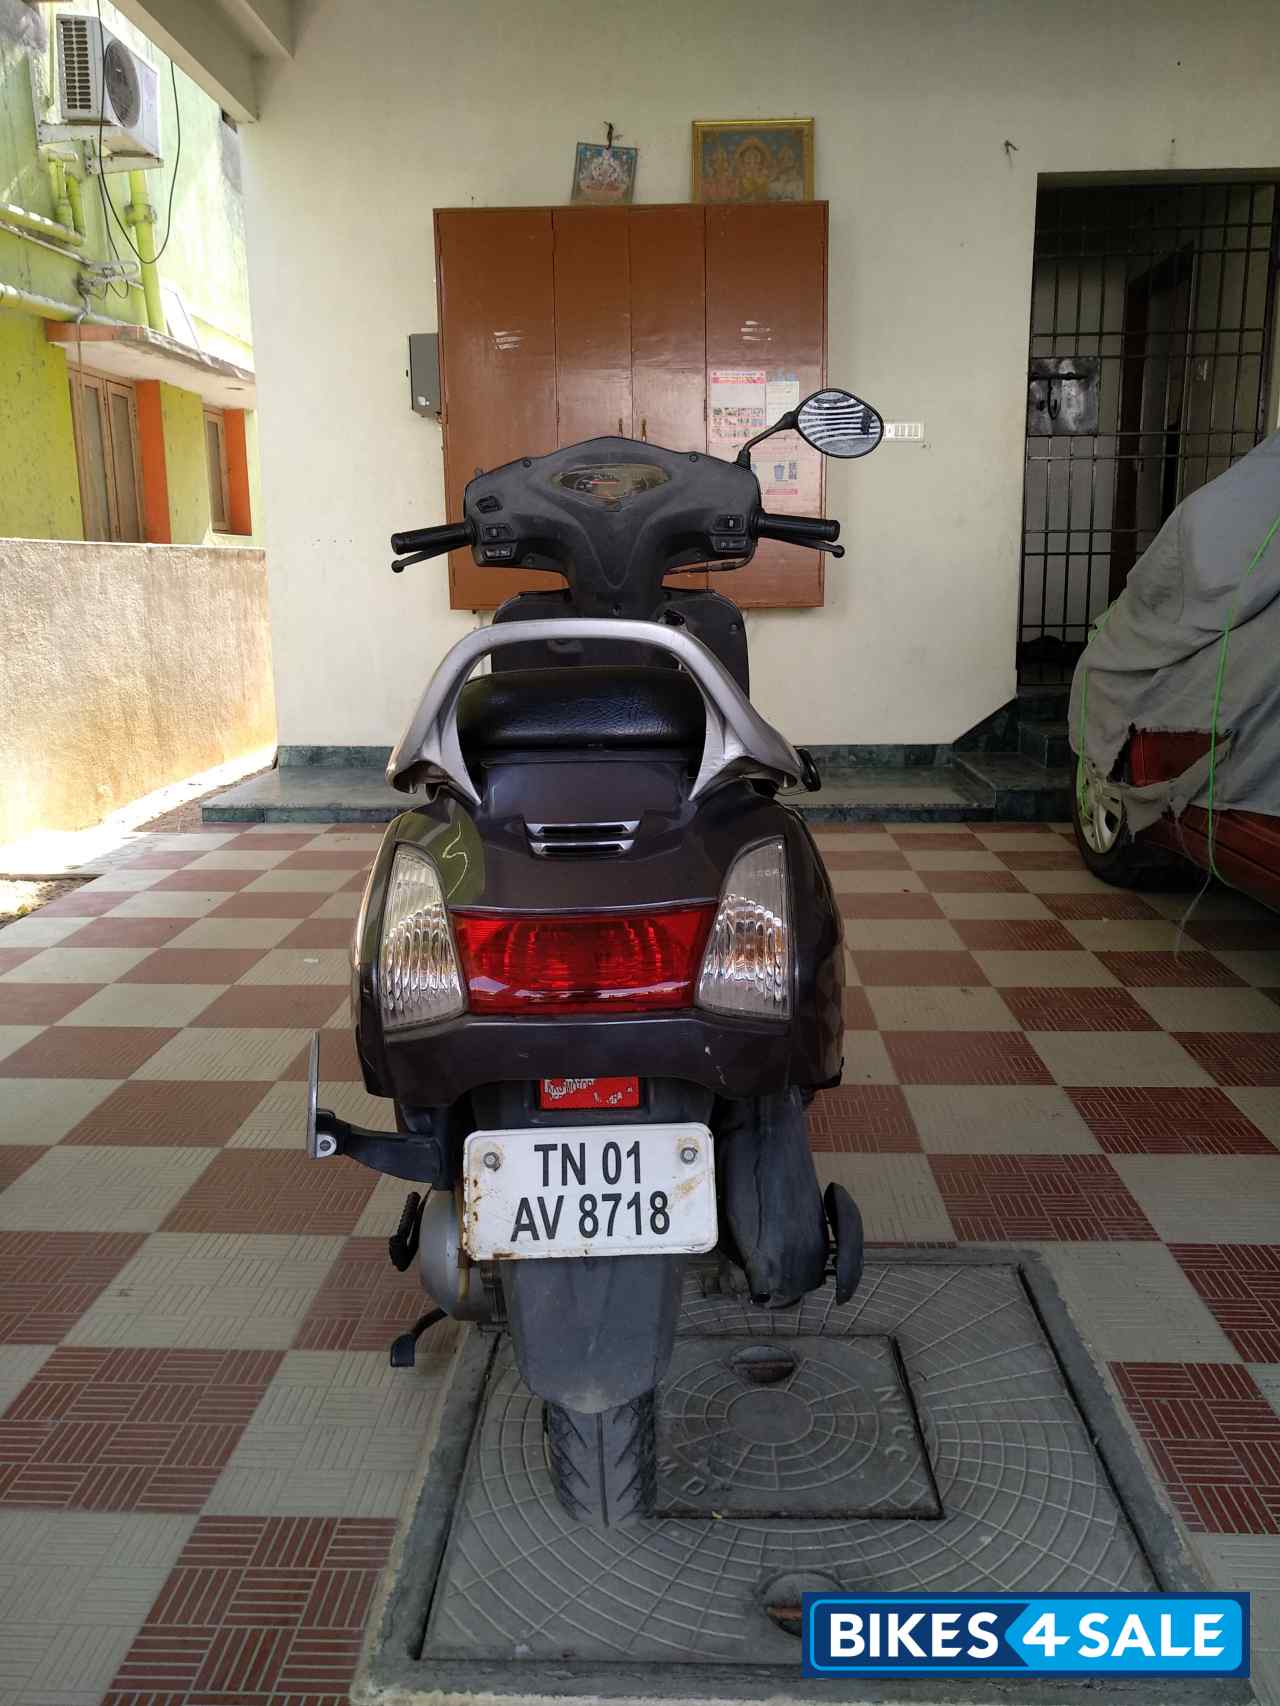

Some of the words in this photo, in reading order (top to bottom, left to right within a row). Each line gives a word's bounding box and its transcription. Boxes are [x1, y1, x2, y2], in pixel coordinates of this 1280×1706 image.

[534, 1142, 586, 1187] TN
[602, 1140, 642, 1186] 01
[510, 1195, 565, 1242] AV
[578, 1190, 671, 1239] 8718
